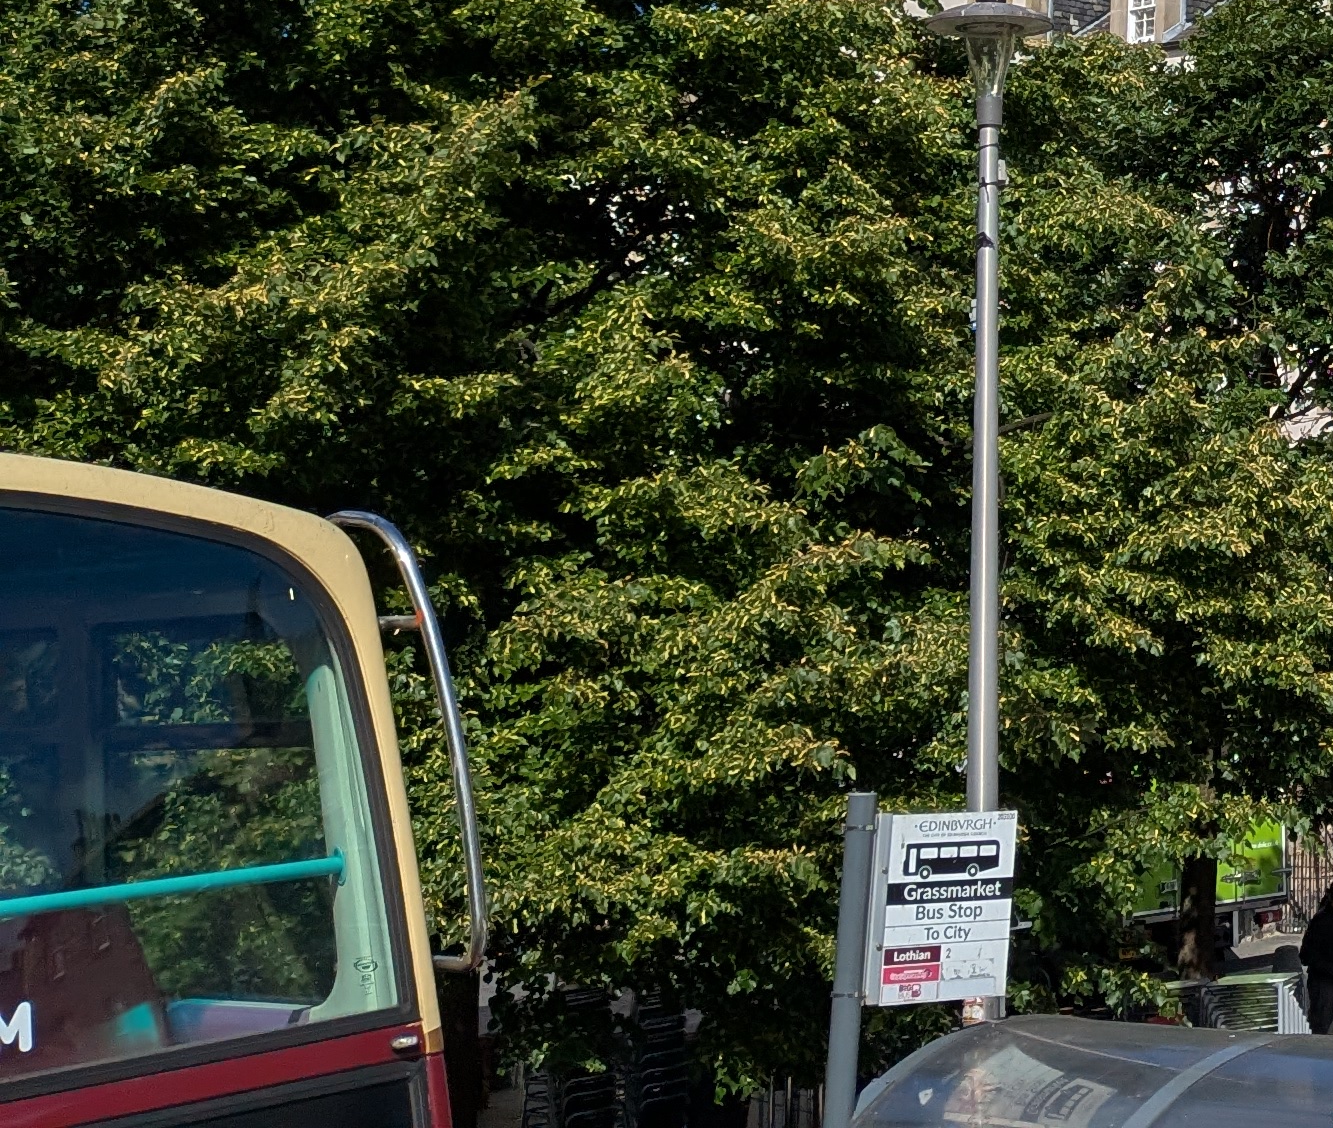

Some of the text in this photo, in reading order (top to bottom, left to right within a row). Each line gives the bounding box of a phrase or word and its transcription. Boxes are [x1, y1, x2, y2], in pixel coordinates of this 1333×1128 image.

[904, 880, 1002, 901] Grassmarket
[915, 903, 983, 921] Bus Stop
[924, 925, 971, 941] To City
[893, 950, 931, 962] Lothian
[945, 948, 951, 959] 2
